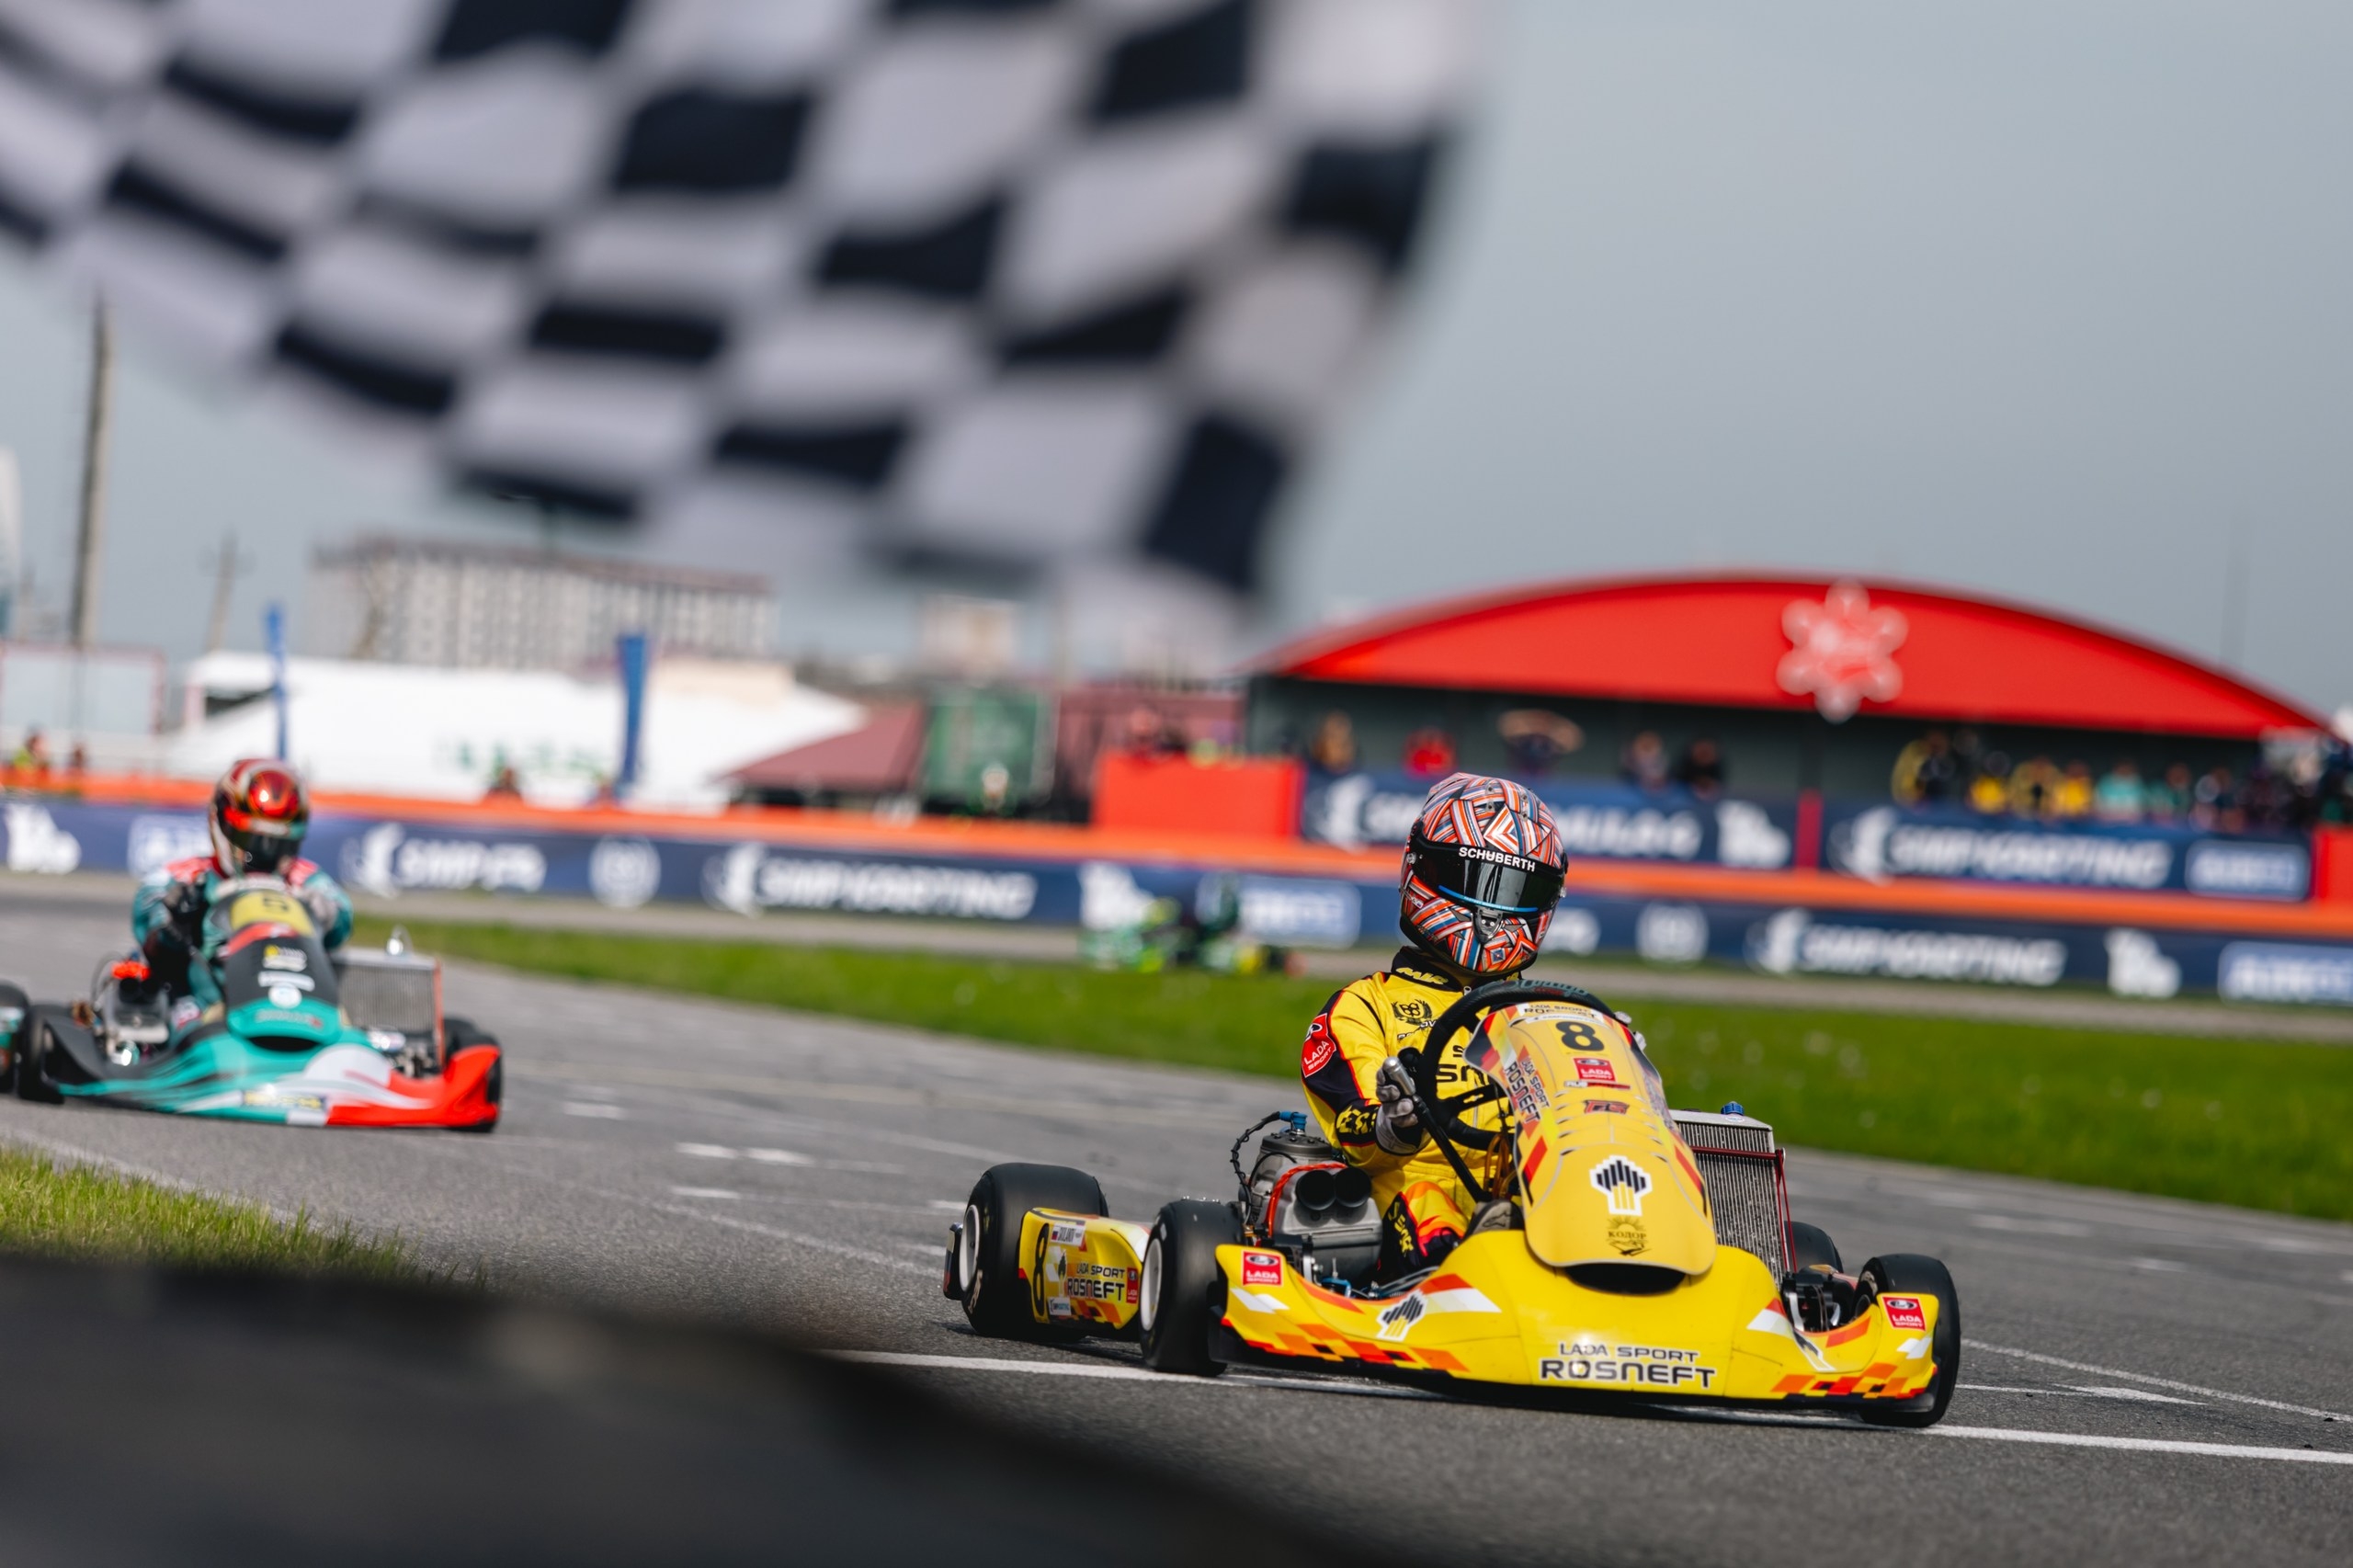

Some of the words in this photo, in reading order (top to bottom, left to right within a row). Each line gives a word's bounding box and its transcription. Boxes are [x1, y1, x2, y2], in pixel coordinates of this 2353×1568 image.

[1459, 847, 1535, 872] SCHUBERTH
[1555, 1021, 1604, 1051] 8
[1304, 1040, 1329, 1064] LADA
[1308, 1047, 1331, 1071] SPORT
[1505, 1061, 1540, 1123] ROSNEFT
[1529, 1076, 1550, 1108] SPORT
[1033, 1223, 1050, 1316] 8
[1076, 1263, 1089, 1275] LADA
[1091, 1265, 1125, 1278] SPORT
[1246, 1270, 1279, 1278] LADA
[1067, 1278, 1125, 1301] ROSNEFT
[1892, 1314, 1922, 1323] LADA
[1560, 1343, 1608, 1356] LADA
[1617, 1346, 1698, 1362] SPORT
[1541, 1359, 1715, 1388] ROSNEFT
